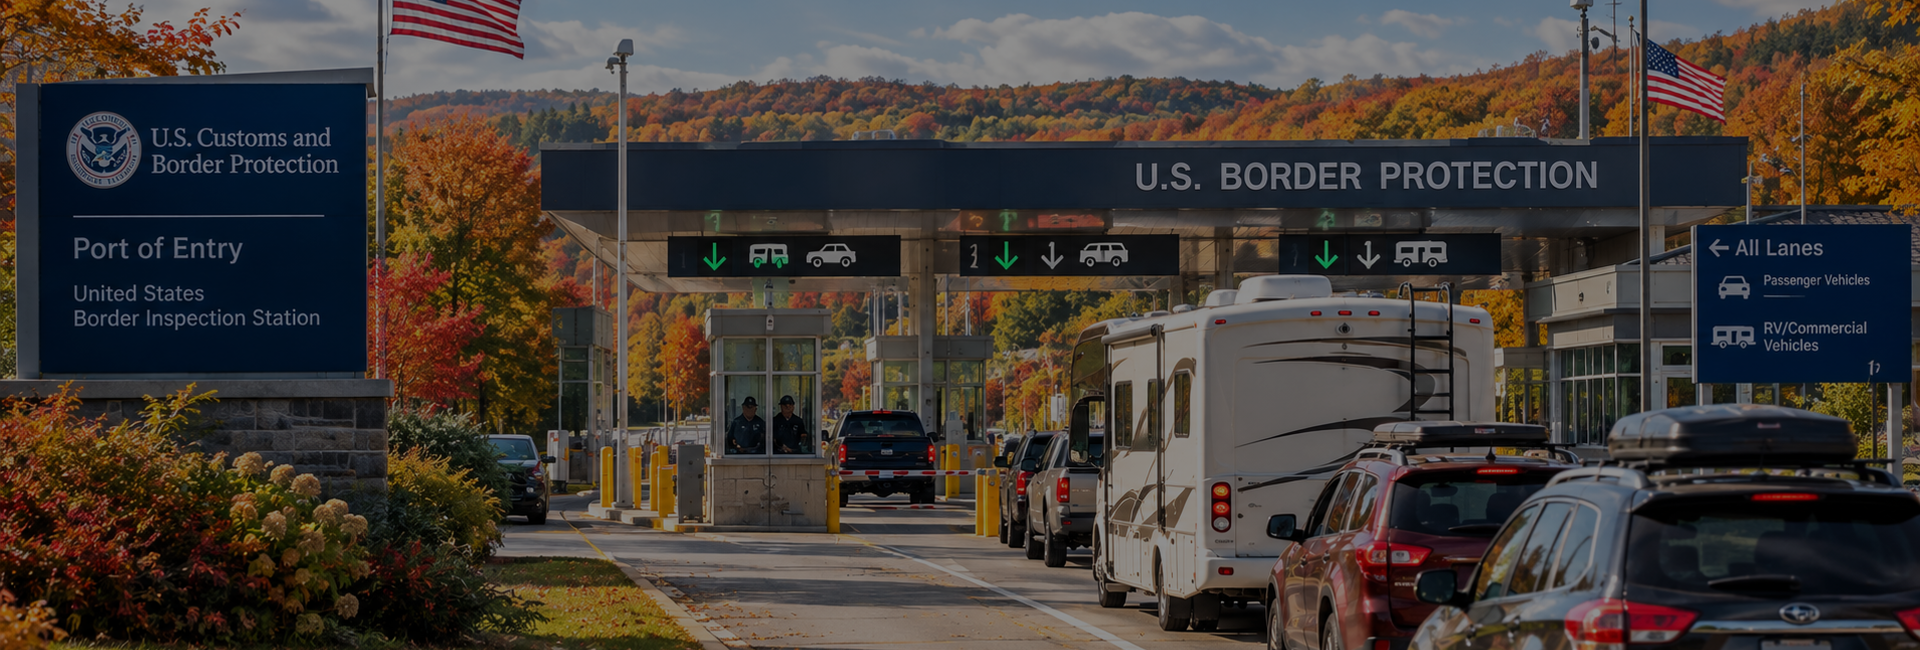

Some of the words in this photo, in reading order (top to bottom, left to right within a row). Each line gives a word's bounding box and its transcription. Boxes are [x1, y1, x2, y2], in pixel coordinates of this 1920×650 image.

[150, 127, 192, 148] U.S.
[197, 127, 288, 148] Customs
[293, 126, 332, 147] and
[151, 153, 225, 174] Border
[229, 153, 339, 174] Protection
[1136, 162, 1201, 191] U.S.
[1220, 161, 1362, 191] BORDER
[1380, 160, 1599, 190] PROTECTION
[73, 237, 129, 260] Port
[137, 236, 165, 260] of
[173, 236, 243, 265] Entry
[1735, 238, 1759, 256] All
[1766, 238, 1824, 256] Lanes
[1763, 274, 1822, 288] Passenger
[1824, 273, 1871, 286] Vehicles
[73, 284, 137, 302] United
[144, 284, 205, 302] States
[73, 308, 140, 327] Border
[146, 308, 246, 331] Inspection
[252, 308, 320, 326] Station
[1763, 320, 1868, 336] RV/Commercial
[1763, 338, 1819, 352] Vehicles
